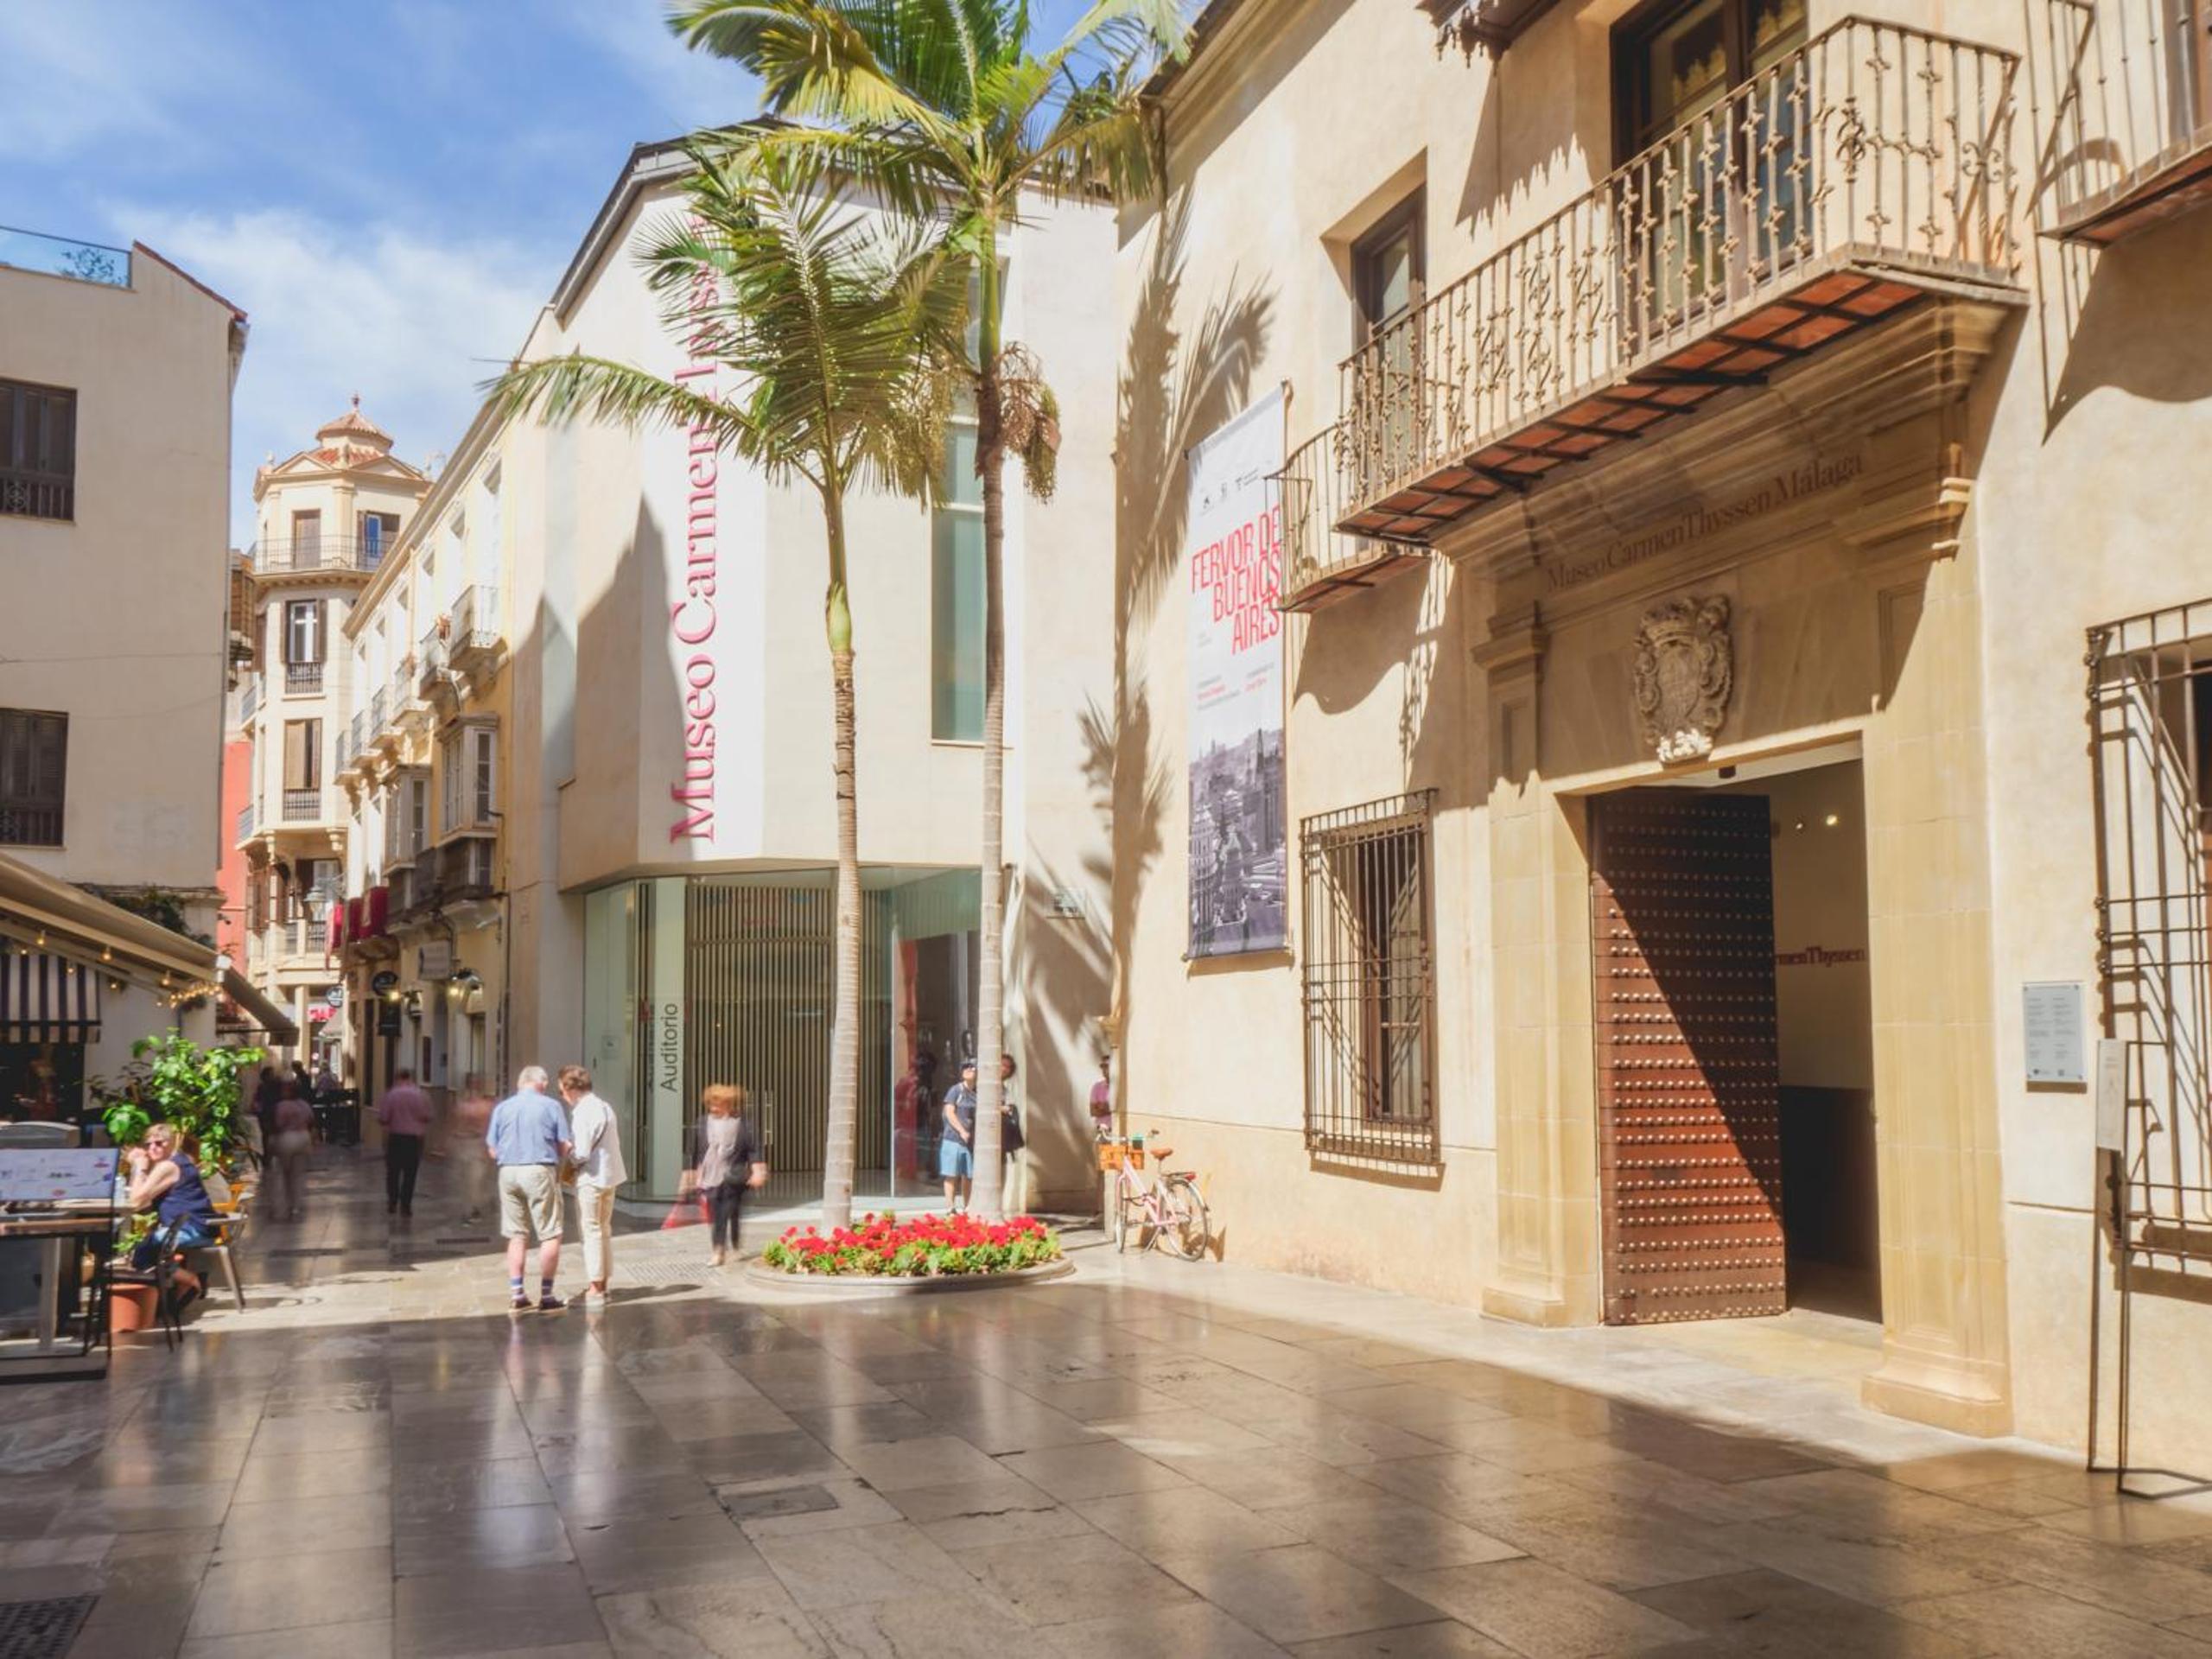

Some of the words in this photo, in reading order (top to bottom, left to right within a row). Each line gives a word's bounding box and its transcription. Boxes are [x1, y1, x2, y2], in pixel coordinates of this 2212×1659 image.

[671, 422, 718, 645] Carmen
[1192, 522, 1255, 594] FERVOR
[1259, 505, 1281, 556] DE
[1546, 560, 1606, 593] Museo
[1607, 524, 1685, 569] Carmen
[1683, 490, 1771, 538] Thyssen
[1213, 549, 1281, 622] BUENOS
[1231, 593, 1280, 655] AIRES
[670, 654, 716, 844] Museo
[660, 1003, 677, 1093] Auditorio
